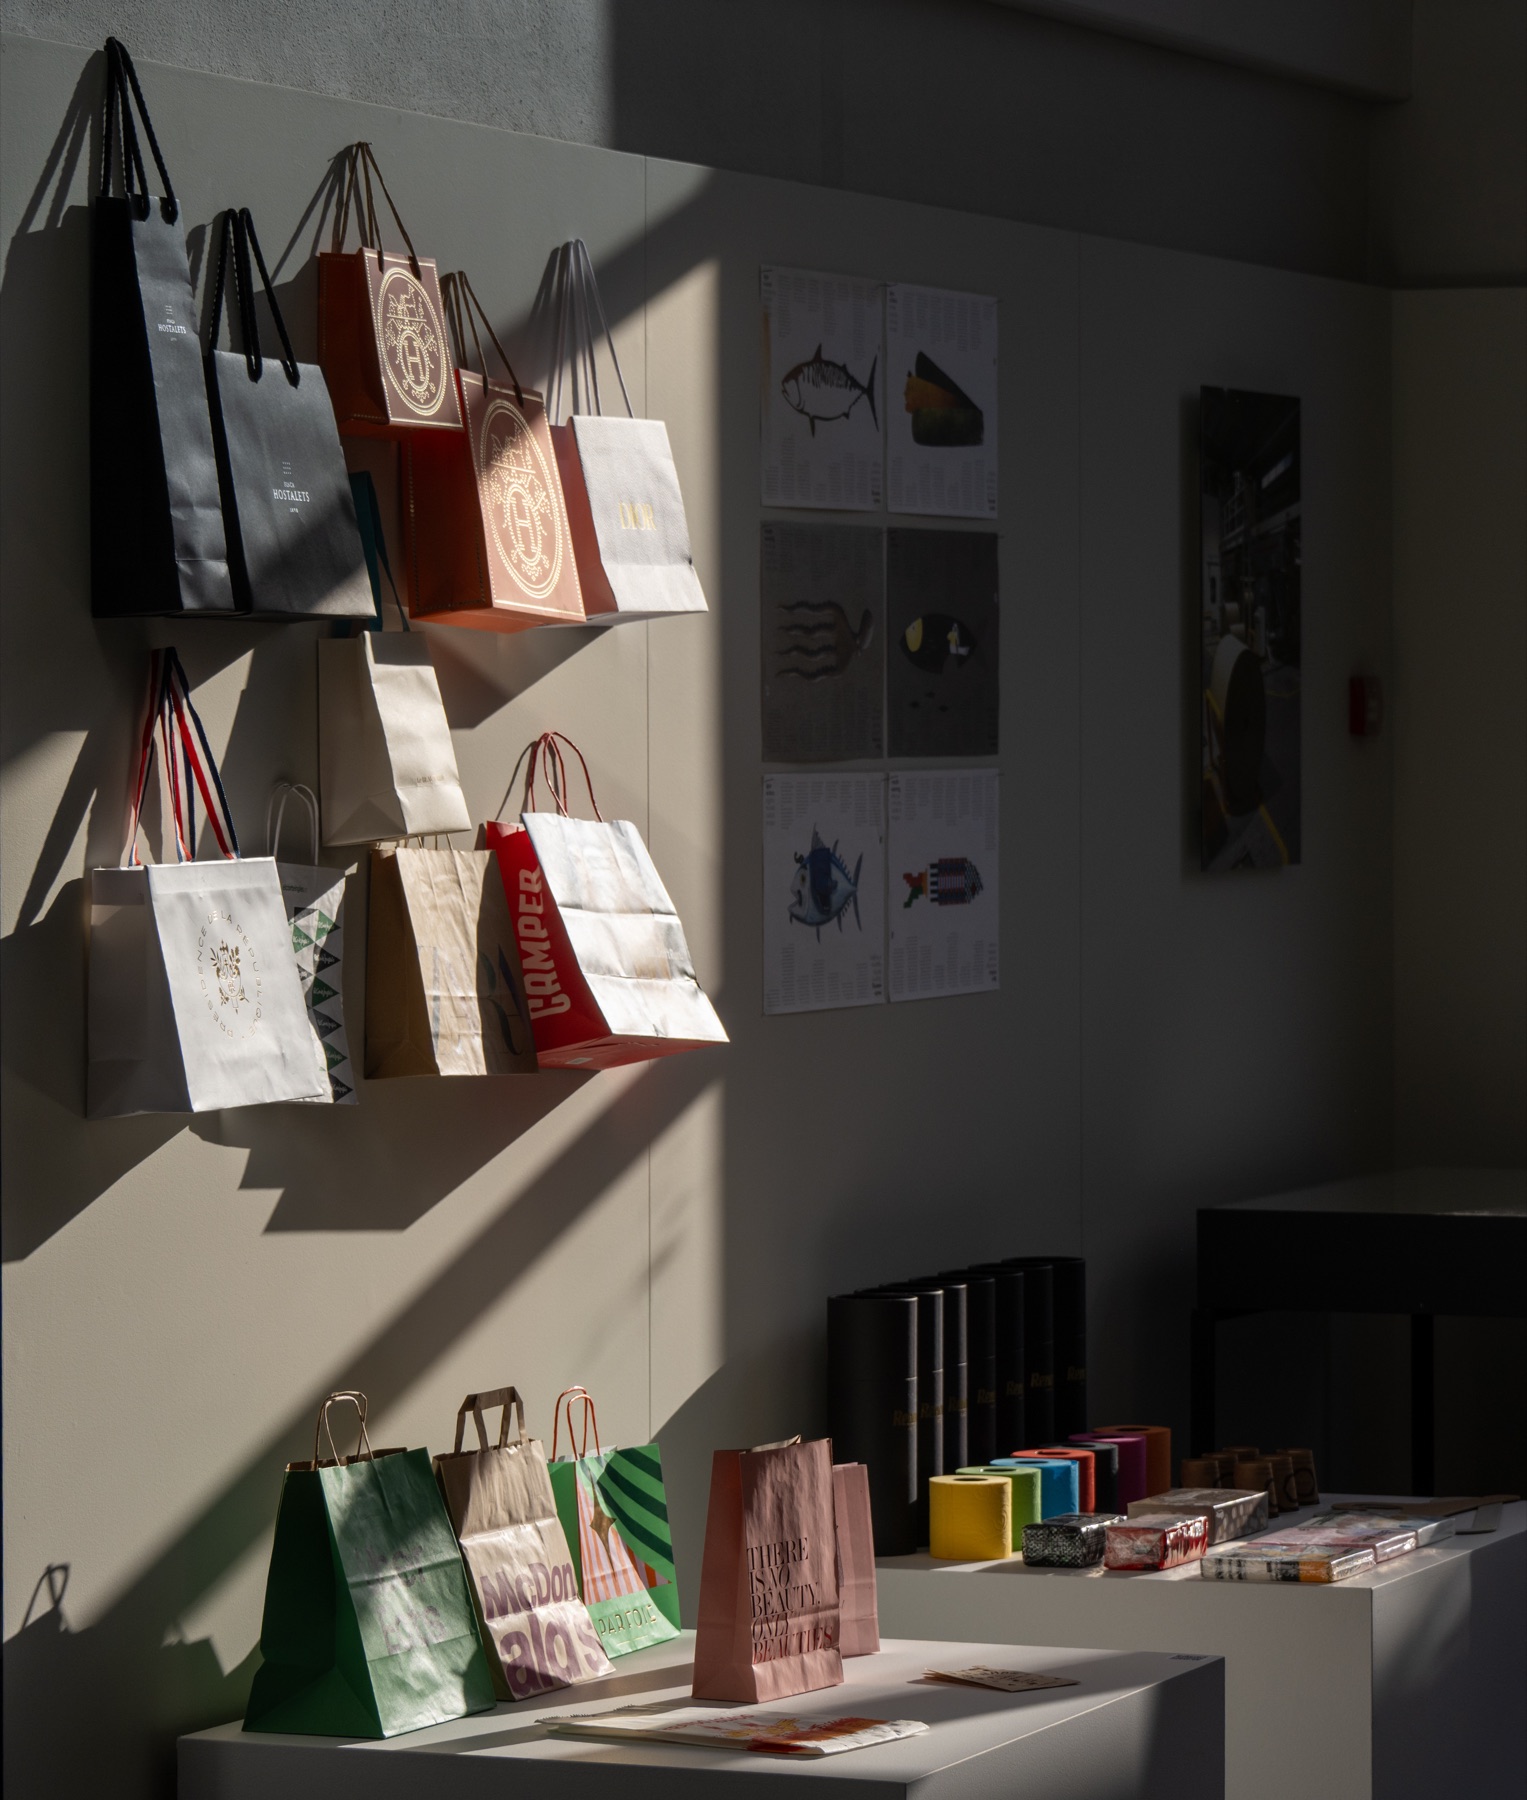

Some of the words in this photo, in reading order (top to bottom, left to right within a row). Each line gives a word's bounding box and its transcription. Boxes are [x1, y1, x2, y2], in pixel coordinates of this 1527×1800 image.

[158, 323, 187, 334] HOSTALETS
[273, 488, 310, 502] HOSTALETS
[619, 501, 656, 531] DIOR
[518, 865, 572, 1020] CAMPER
[747, 1537, 809, 1570] THERE
[480, 1562, 578, 1620] McDon
[750, 1568, 766, 1595] IS
[767, 1565, 790, 1593] NO
[751, 1581, 821, 1618] BEAUTY.
[752, 1610, 793, 1642] ONLY
[752, 1625, 833, 1664] BEAUTIES
